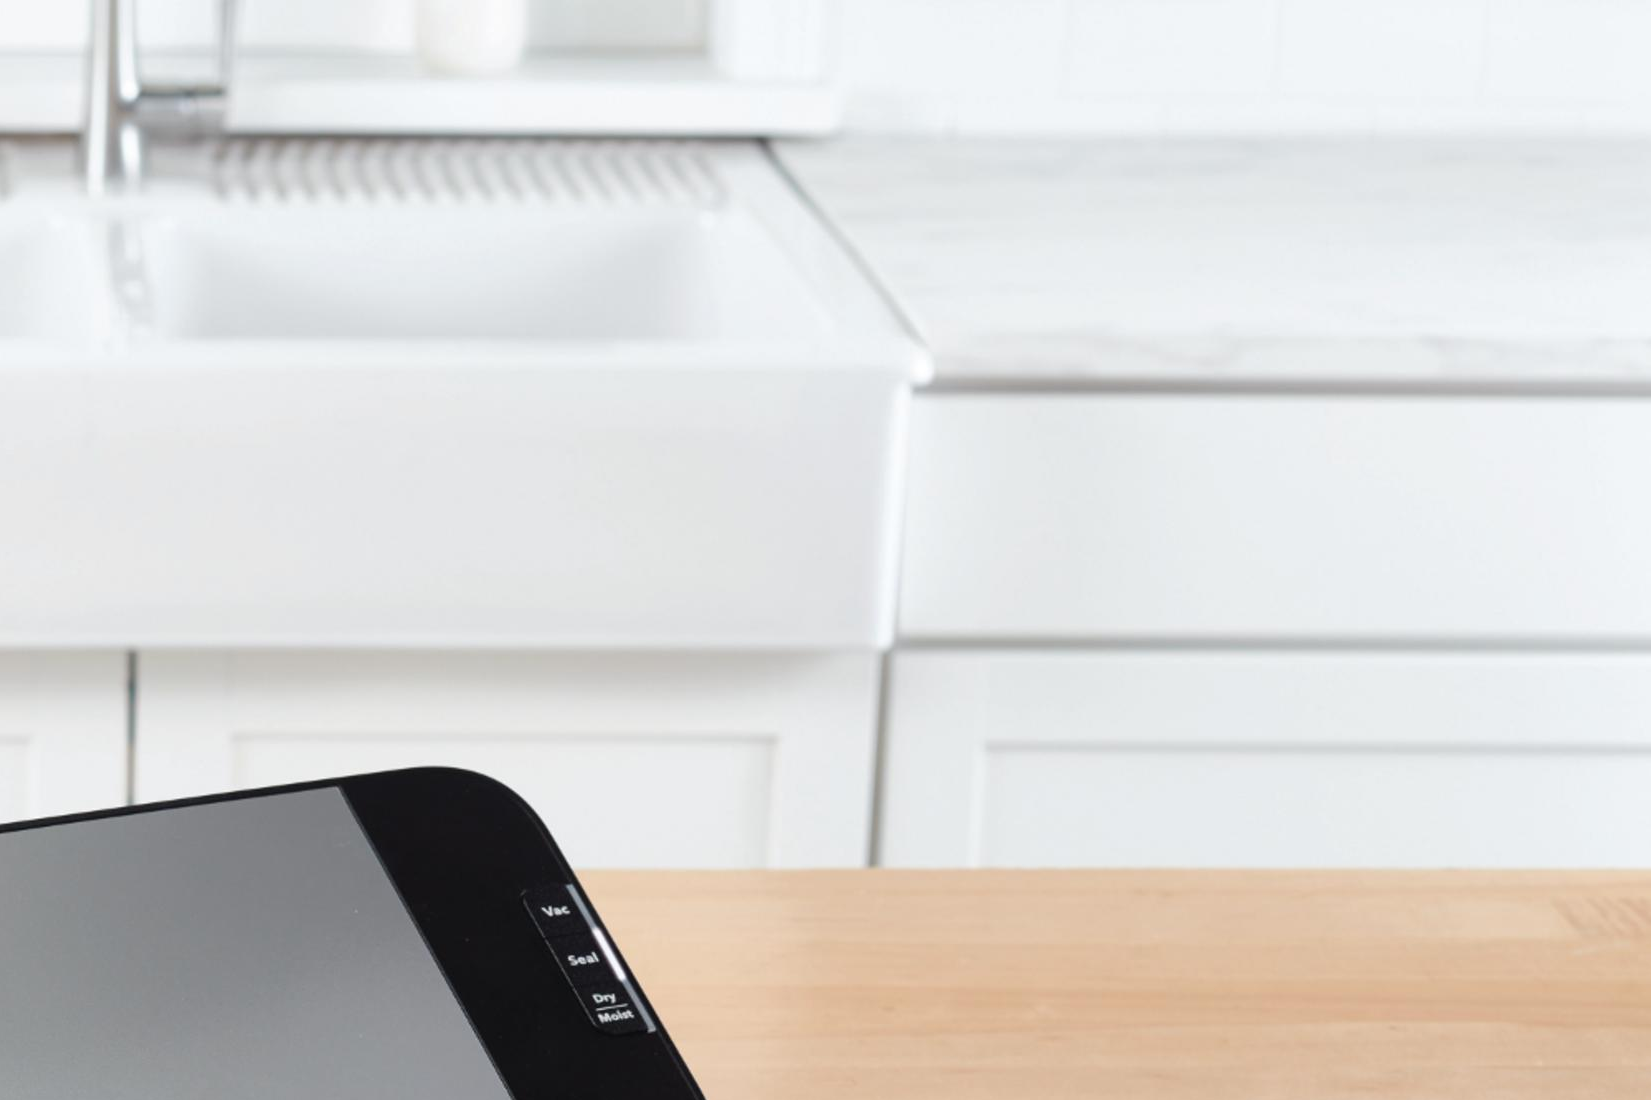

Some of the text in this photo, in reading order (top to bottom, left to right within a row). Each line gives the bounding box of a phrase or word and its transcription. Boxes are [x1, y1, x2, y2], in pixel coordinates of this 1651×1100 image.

[540, 905, 571, 917] Vac
[567, 951, 600, 966] Seal
[592, 992, 617, 1004] Dry
[597, 1009, 635, 1024] Moist
